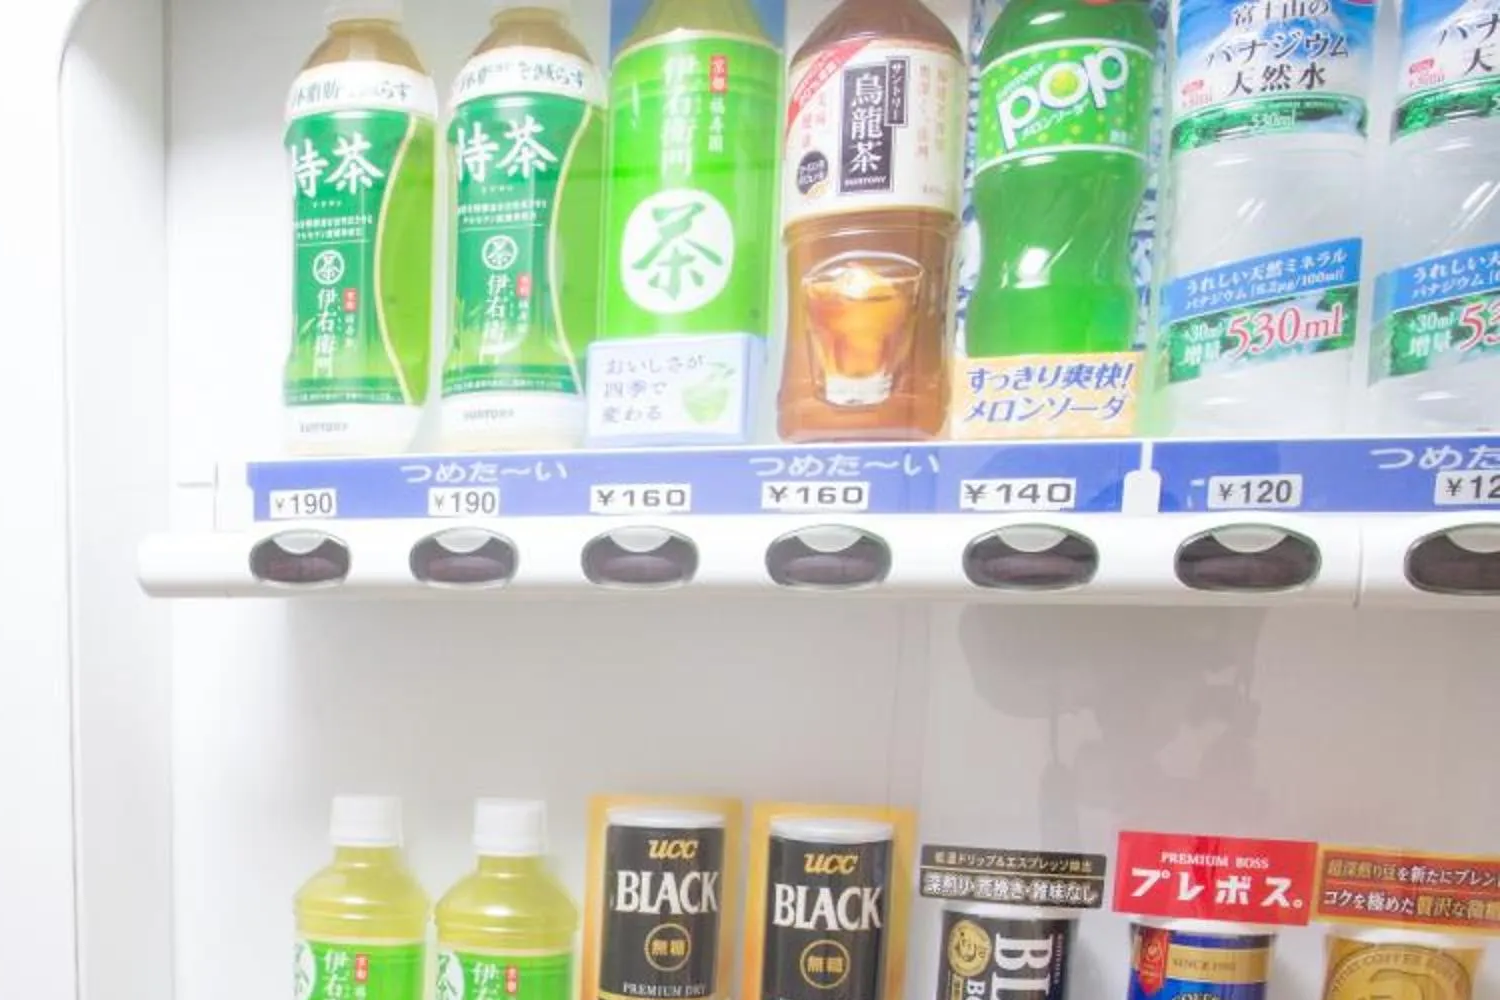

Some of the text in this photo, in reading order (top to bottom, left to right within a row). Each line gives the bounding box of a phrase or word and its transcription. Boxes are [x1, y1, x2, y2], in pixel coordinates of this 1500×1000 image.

[1228, 63, 1327, 97] 天然水
[997, 47, 1130, 150] pop
[850, 72, 885, 174] 烏龍茶
[631, 201, 724, 301] 茶
[1226, 302, 1344, 358] 530ml
[967, 362, 1135, 393] すっきり爽快!
[603, 405, 663, 423] 変わる
[964, 395, 1127, 423] メロンソーダ
[274, 492, 334, 515] ¥190
[434, 491, 497, 514] ¥190
[597, 488, 687, 507] ¥160
[769, 485, 865, 506] ¥160
[964, 483, 1073, 504] ¥140
[1219, 479, 1293, 503] ¥120
[1161, 851, 1269, 869] PREMIUM BOSS
[615, 870, 721, 915] BLACK
[772, 882, 882, 931] BLACK
[623, 982, 680, 998] PREMIUM
